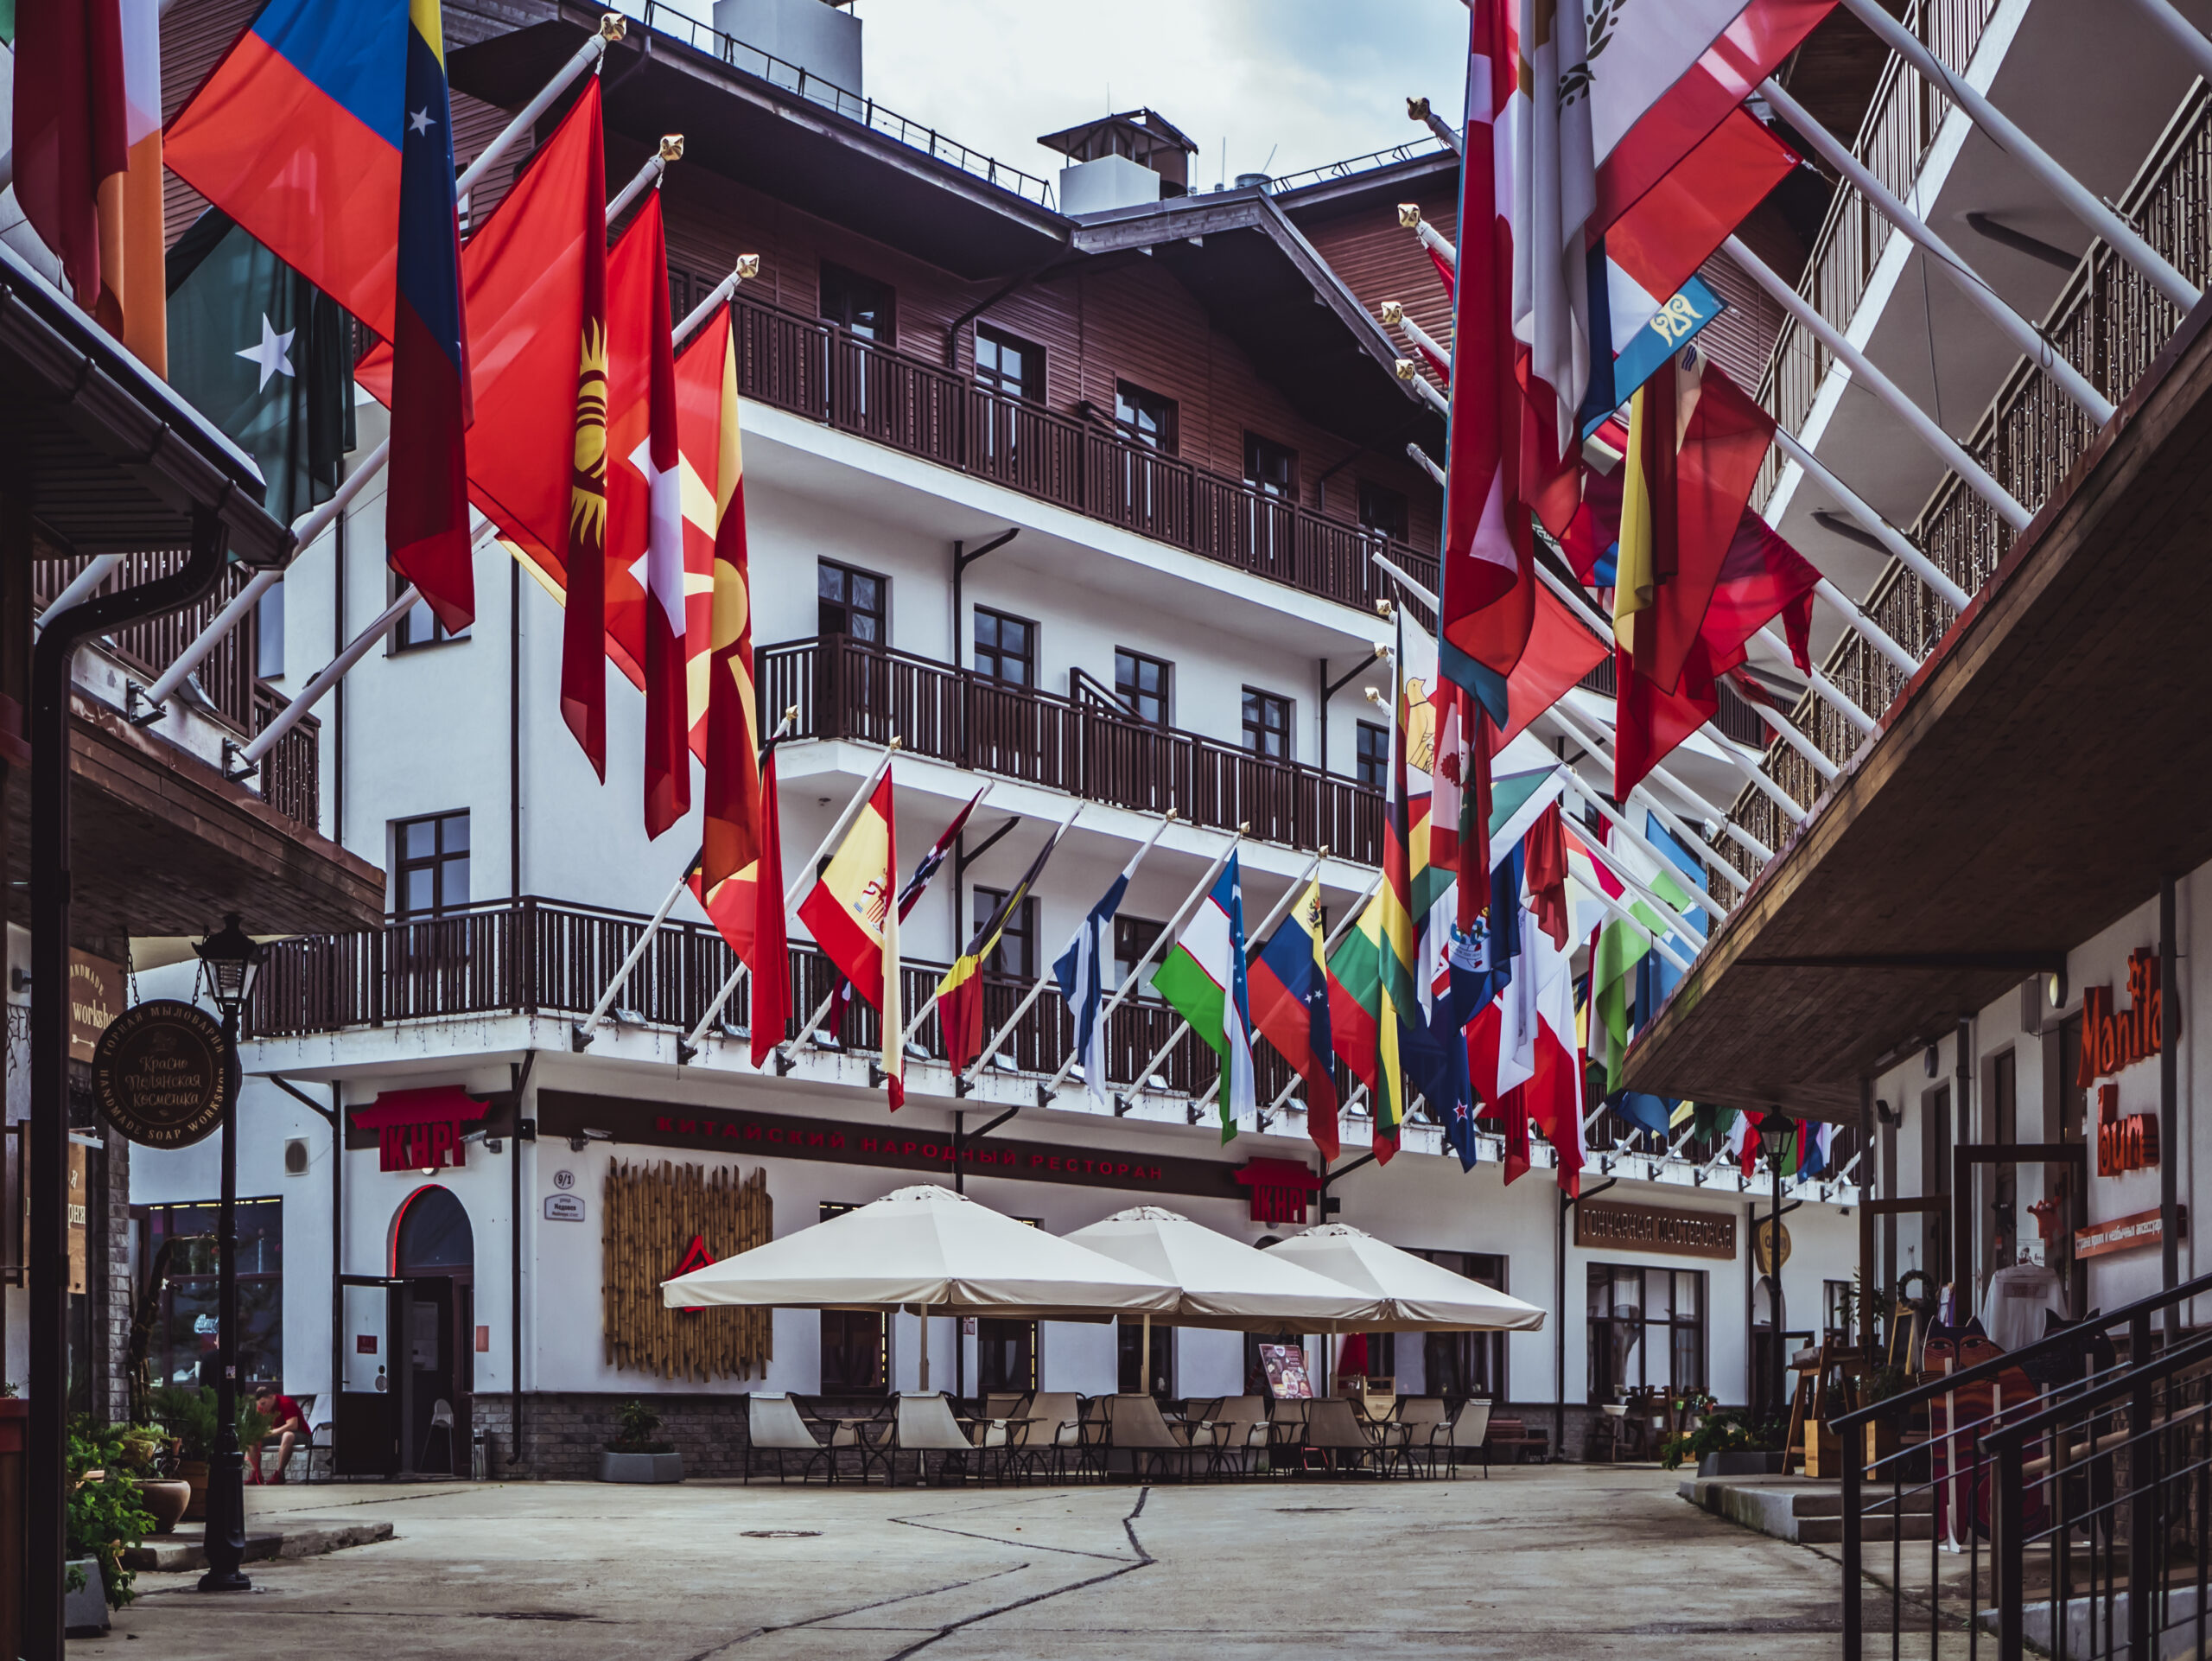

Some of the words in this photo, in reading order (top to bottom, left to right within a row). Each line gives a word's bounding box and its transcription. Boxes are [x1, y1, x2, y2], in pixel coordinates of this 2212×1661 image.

[69, 960, 105, 996] ANDMADE
[72, 999, 118, 1030] worksho
[103, 1013, 144, 1057] ГОРНАЯ
[150, 1006, 226, 1053] МЫЛОВАРНЯ
[99, 1069, 143, 1136] HANDMADE
[148, 1129, 181, 1141] SOAP
[655, 1116, 846, 1149] КИТАЙСКИЙ
[861, 1137, 1016, 1166] НАРОДНЫЙ
[1032, 1155, 1162, 1180] РЕСТОРАН
[557, 1174, 572, 1187] 9/1
[1583, 1209, 1653, 1241] ГОНЧАРНАЯ
[1657, 1217, 1732, 1249] МАСТЕРСКАЯ
[2136, 1219, 2162, 1236] аксессуар
